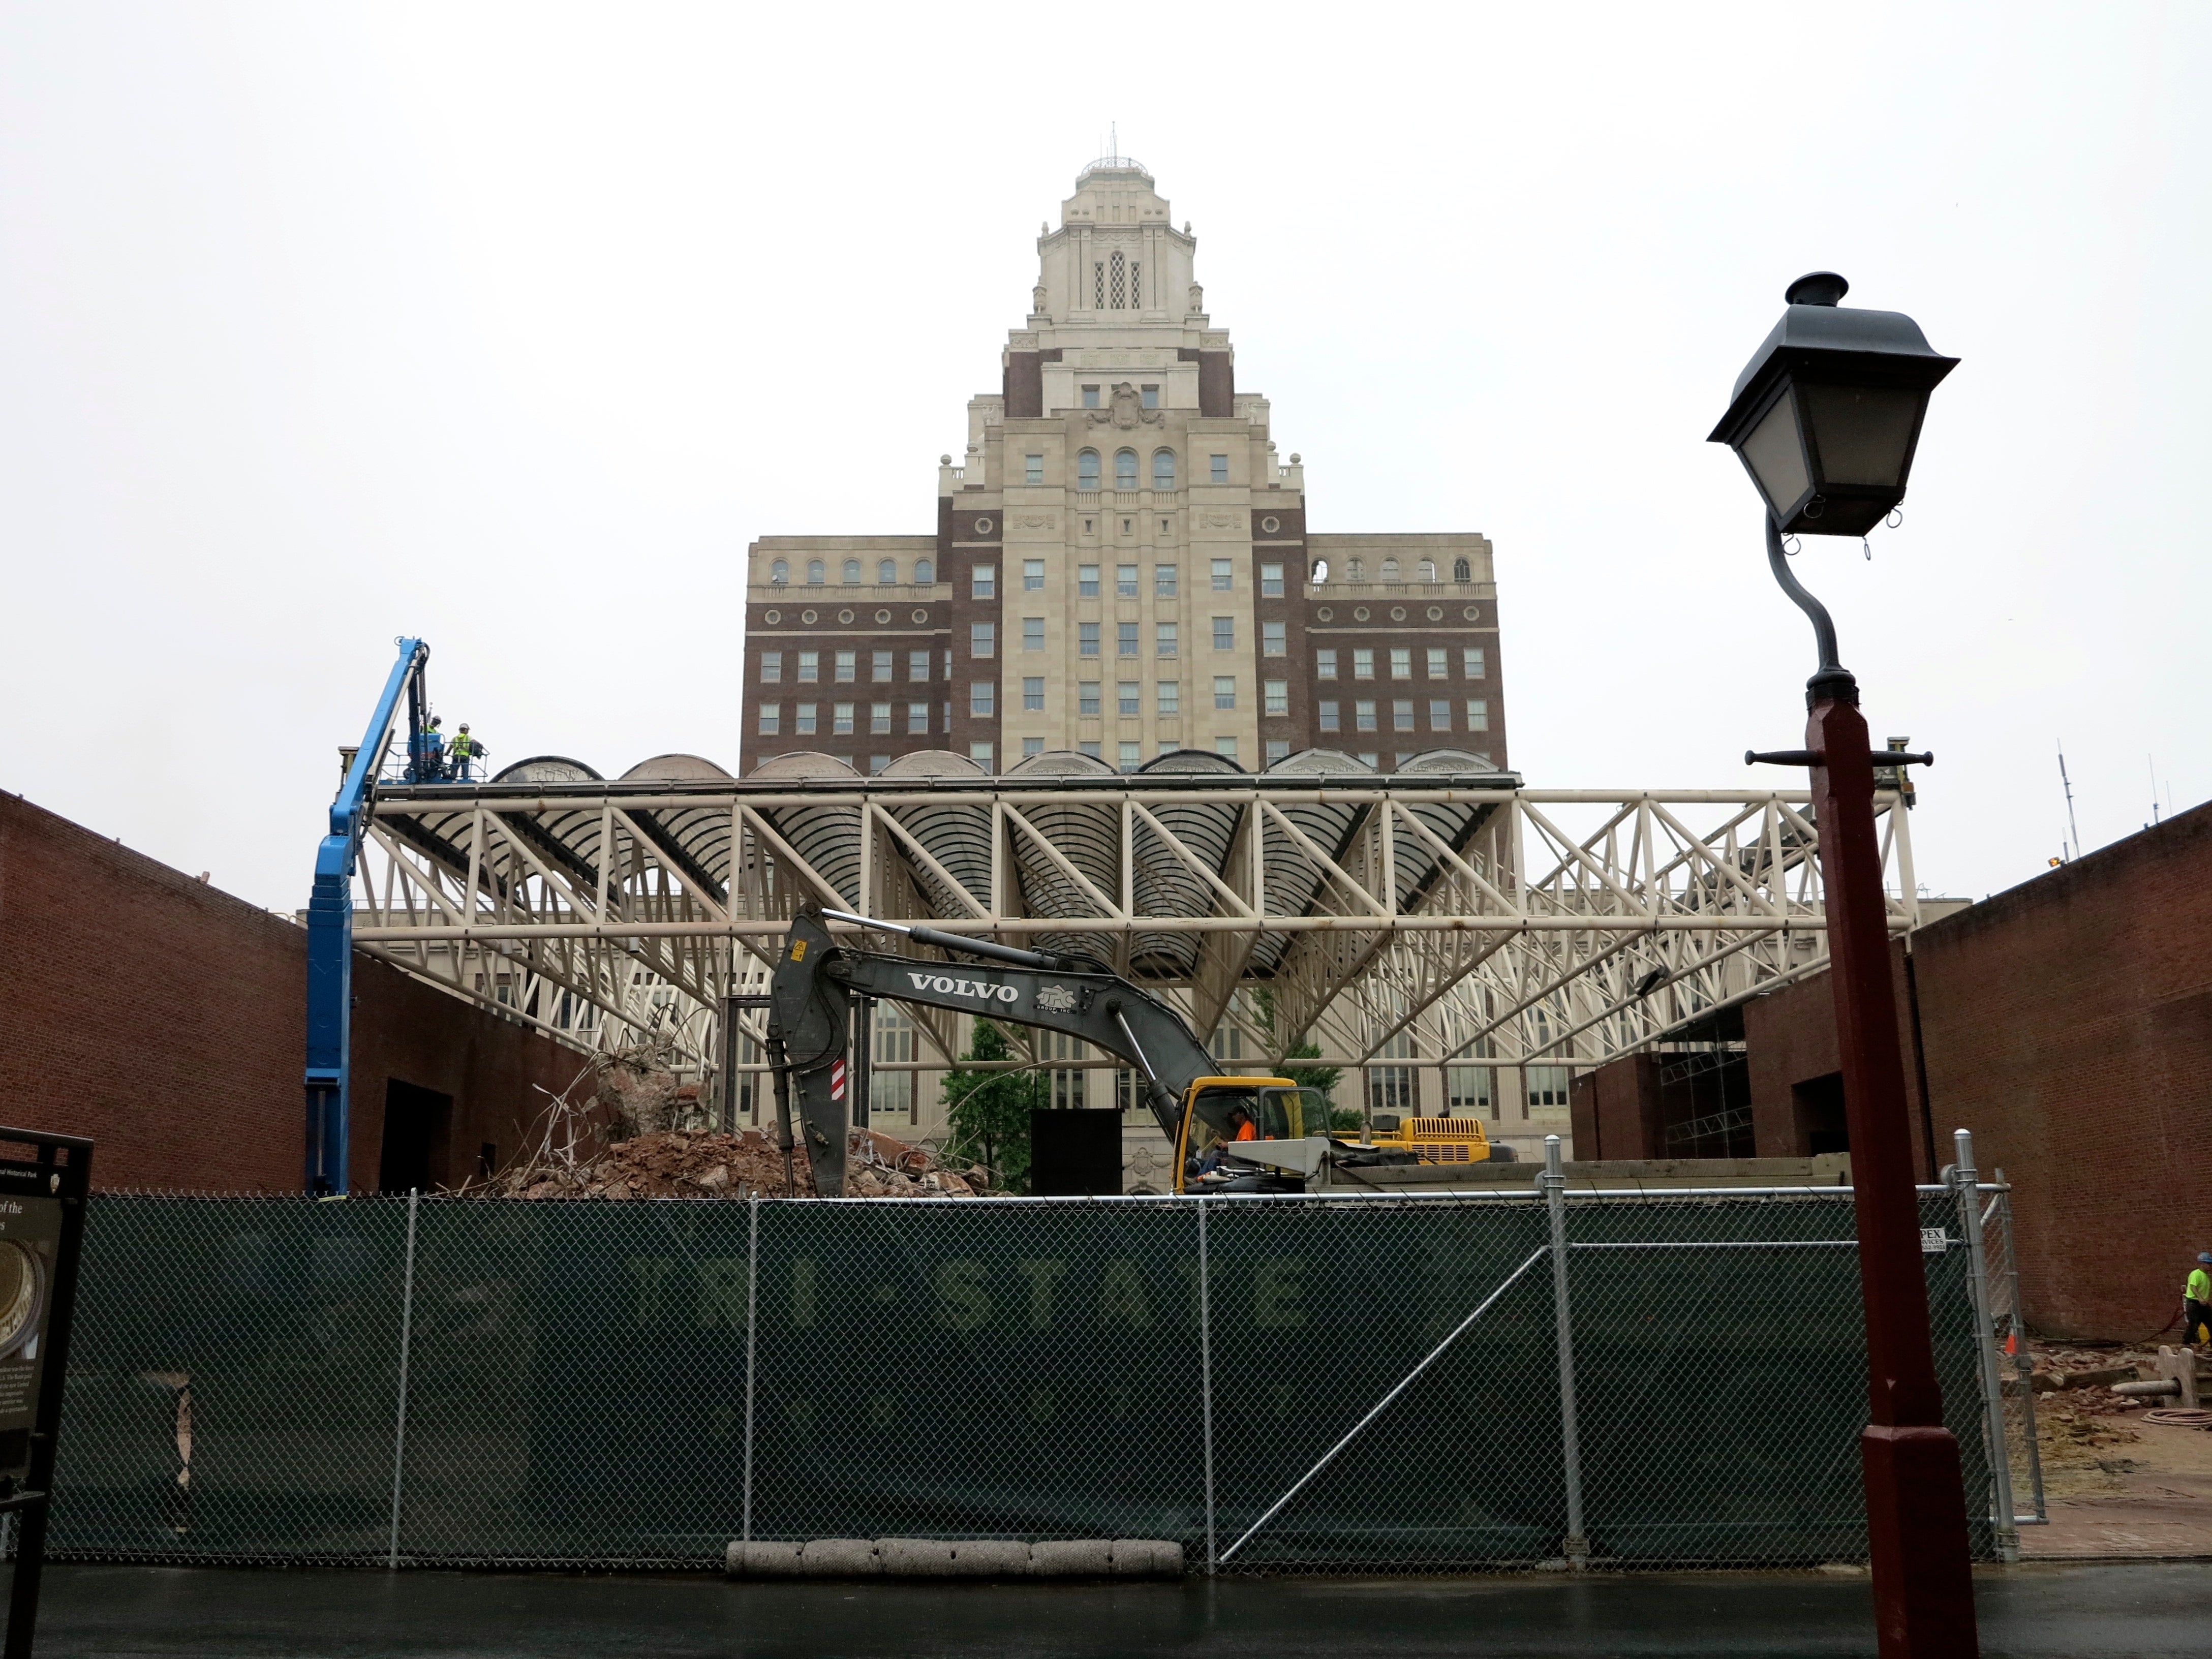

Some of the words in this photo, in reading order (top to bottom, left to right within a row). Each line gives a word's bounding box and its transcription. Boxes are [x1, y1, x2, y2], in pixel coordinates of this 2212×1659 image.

[907, 972, 1019, 1002] VOLVO
[7, 1169, 27, 1177] Historical
[9, 1202, 22, 1214] the
